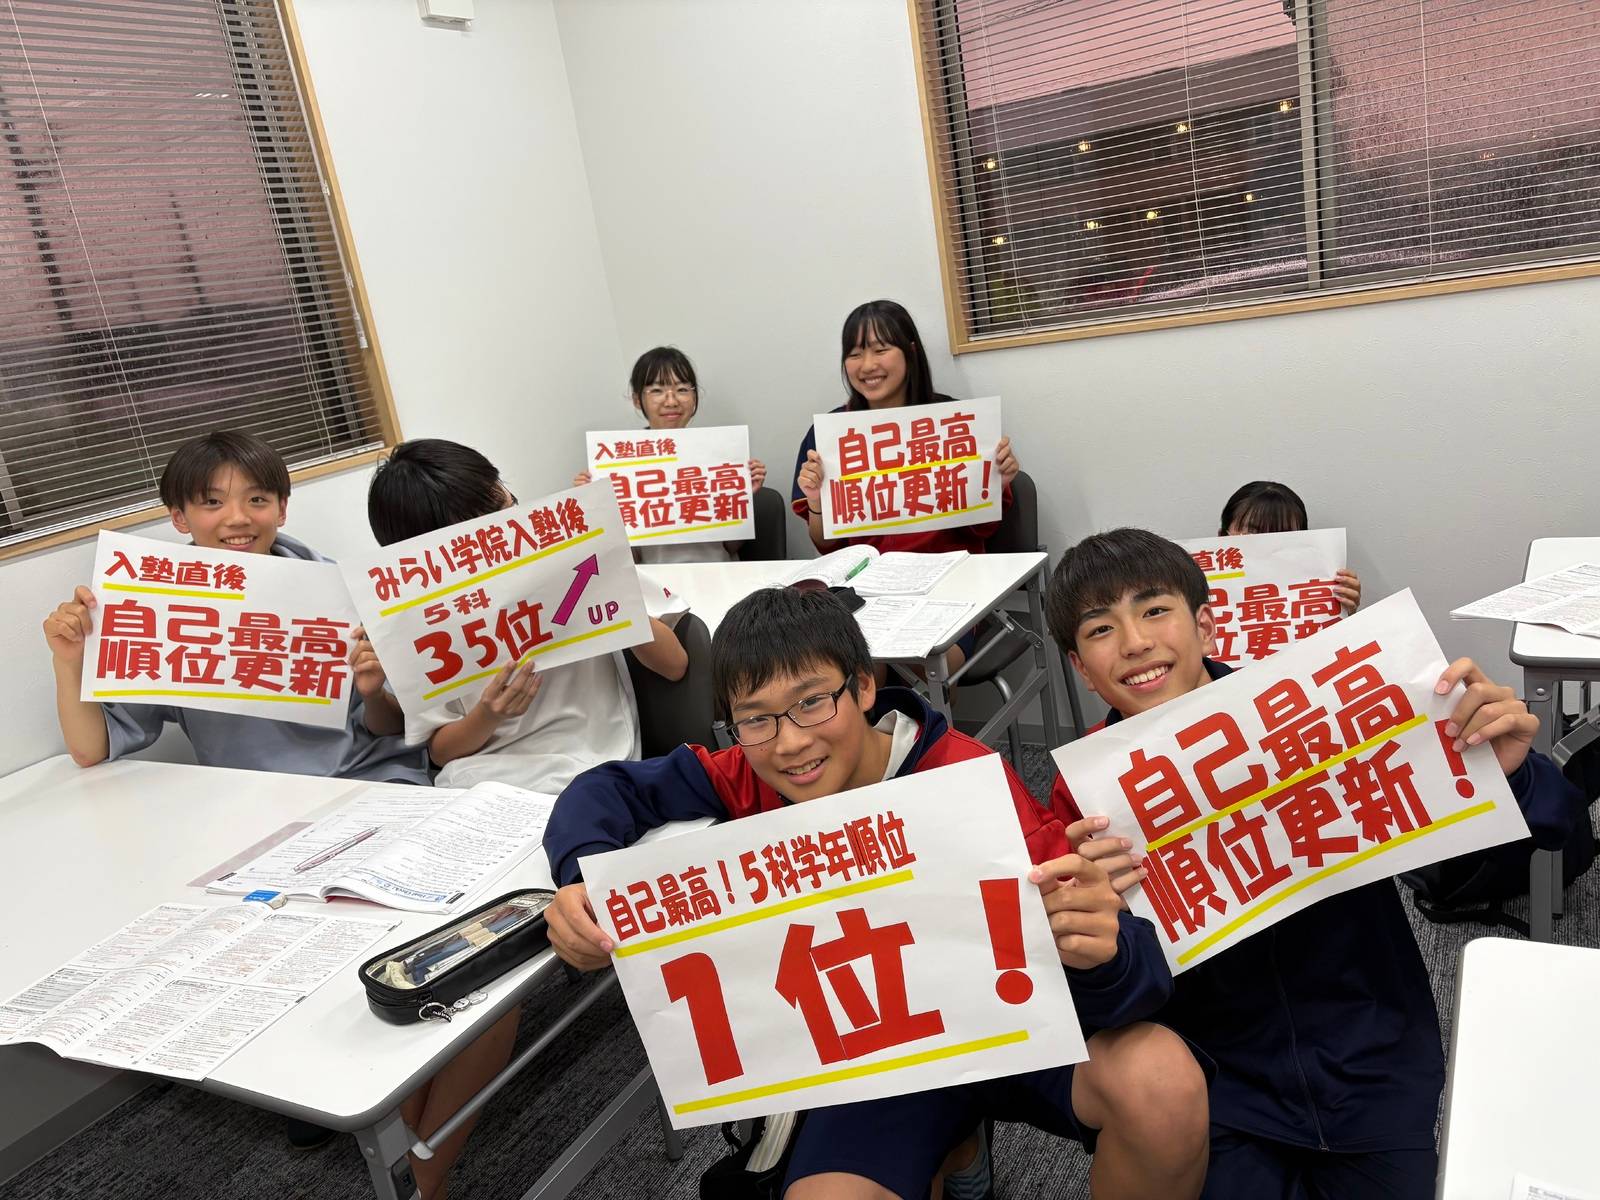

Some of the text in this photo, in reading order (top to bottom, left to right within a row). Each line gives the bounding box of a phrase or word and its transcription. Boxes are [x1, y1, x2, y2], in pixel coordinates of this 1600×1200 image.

[594, 438, 678, 460] 入塾直後
[838, 412, 978, 477] 自己最高
[829, 460, 992, 525] 順位更新！
[104, 550, 247, 591] 入塾直後
[368, 498, 589, 602] みらい学院入塾後
[100, 599, 350, 658] 自己最高
[424, 588, 491, 625] 5科
[588, 600, 619, 625] UP
[96, 638, 348, 699] 順位更新
[413, 600, 554, 685] 35位
[1118, 640, 1416, 844] 自己最高
[1139, 718, 1475, 944] 順位更新！
[605, 811, 917, 941] 自己最高！5科学年順位
